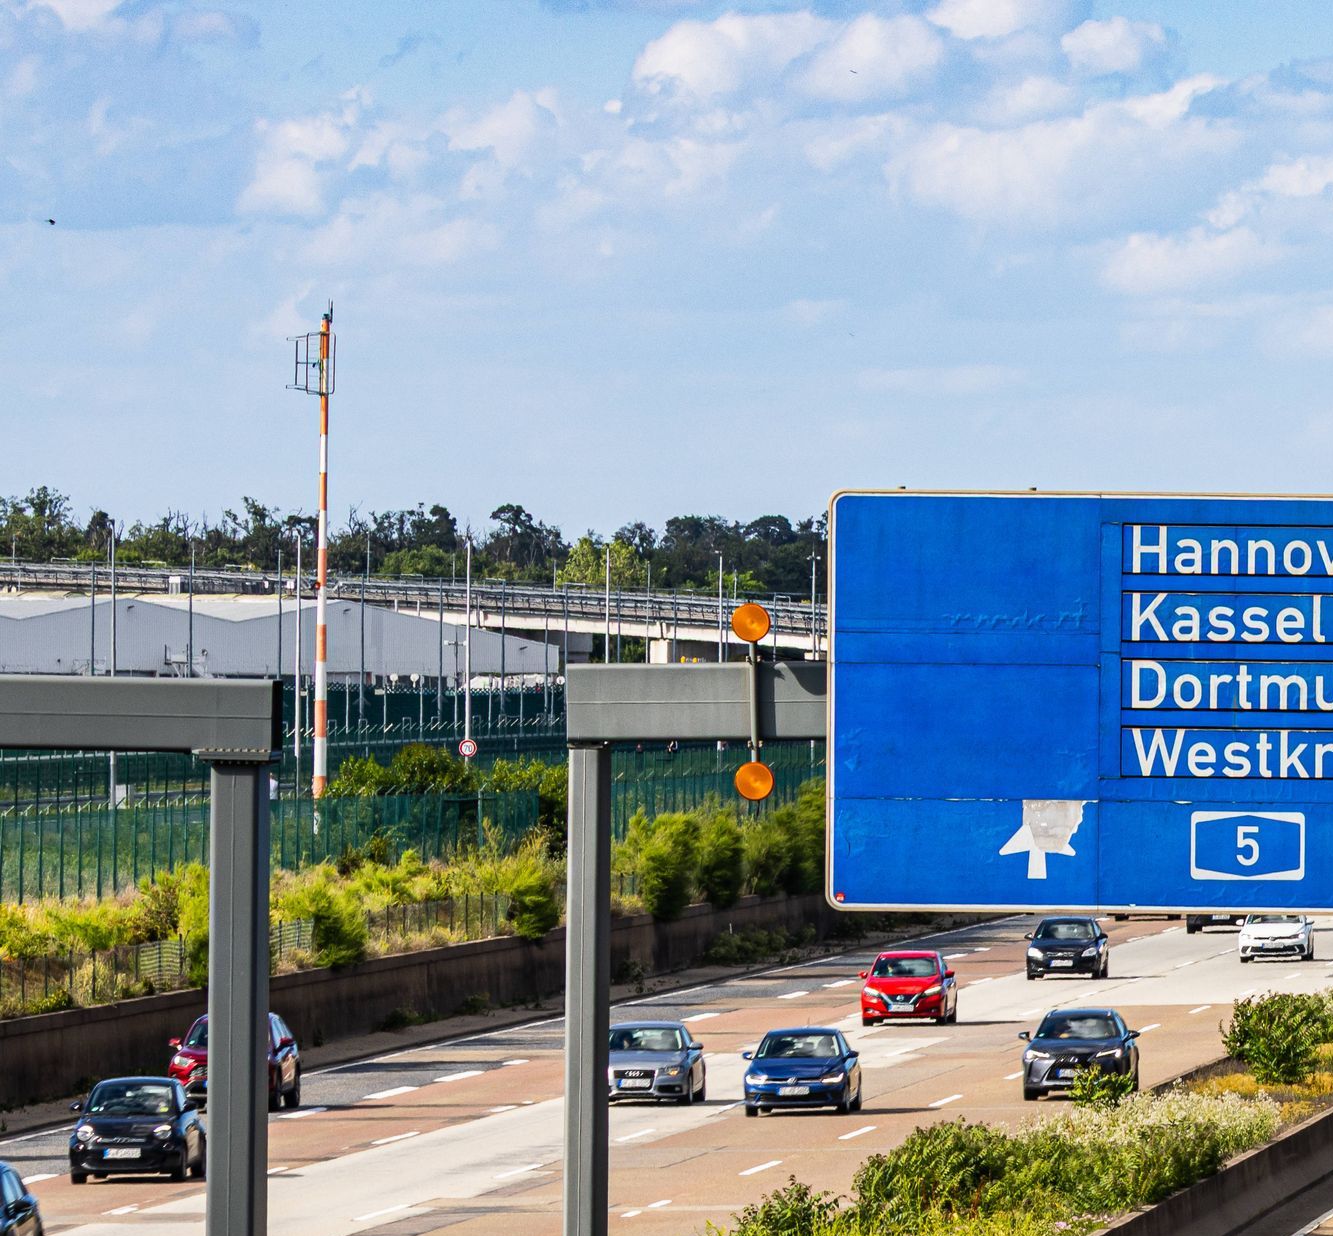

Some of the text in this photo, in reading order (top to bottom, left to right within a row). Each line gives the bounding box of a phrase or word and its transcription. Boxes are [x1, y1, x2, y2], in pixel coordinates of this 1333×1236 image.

[1131, 594, 1326, 643] Kassel
[463, 744, 473, 753] 70
[1235, 826, 1260, 867] 5
